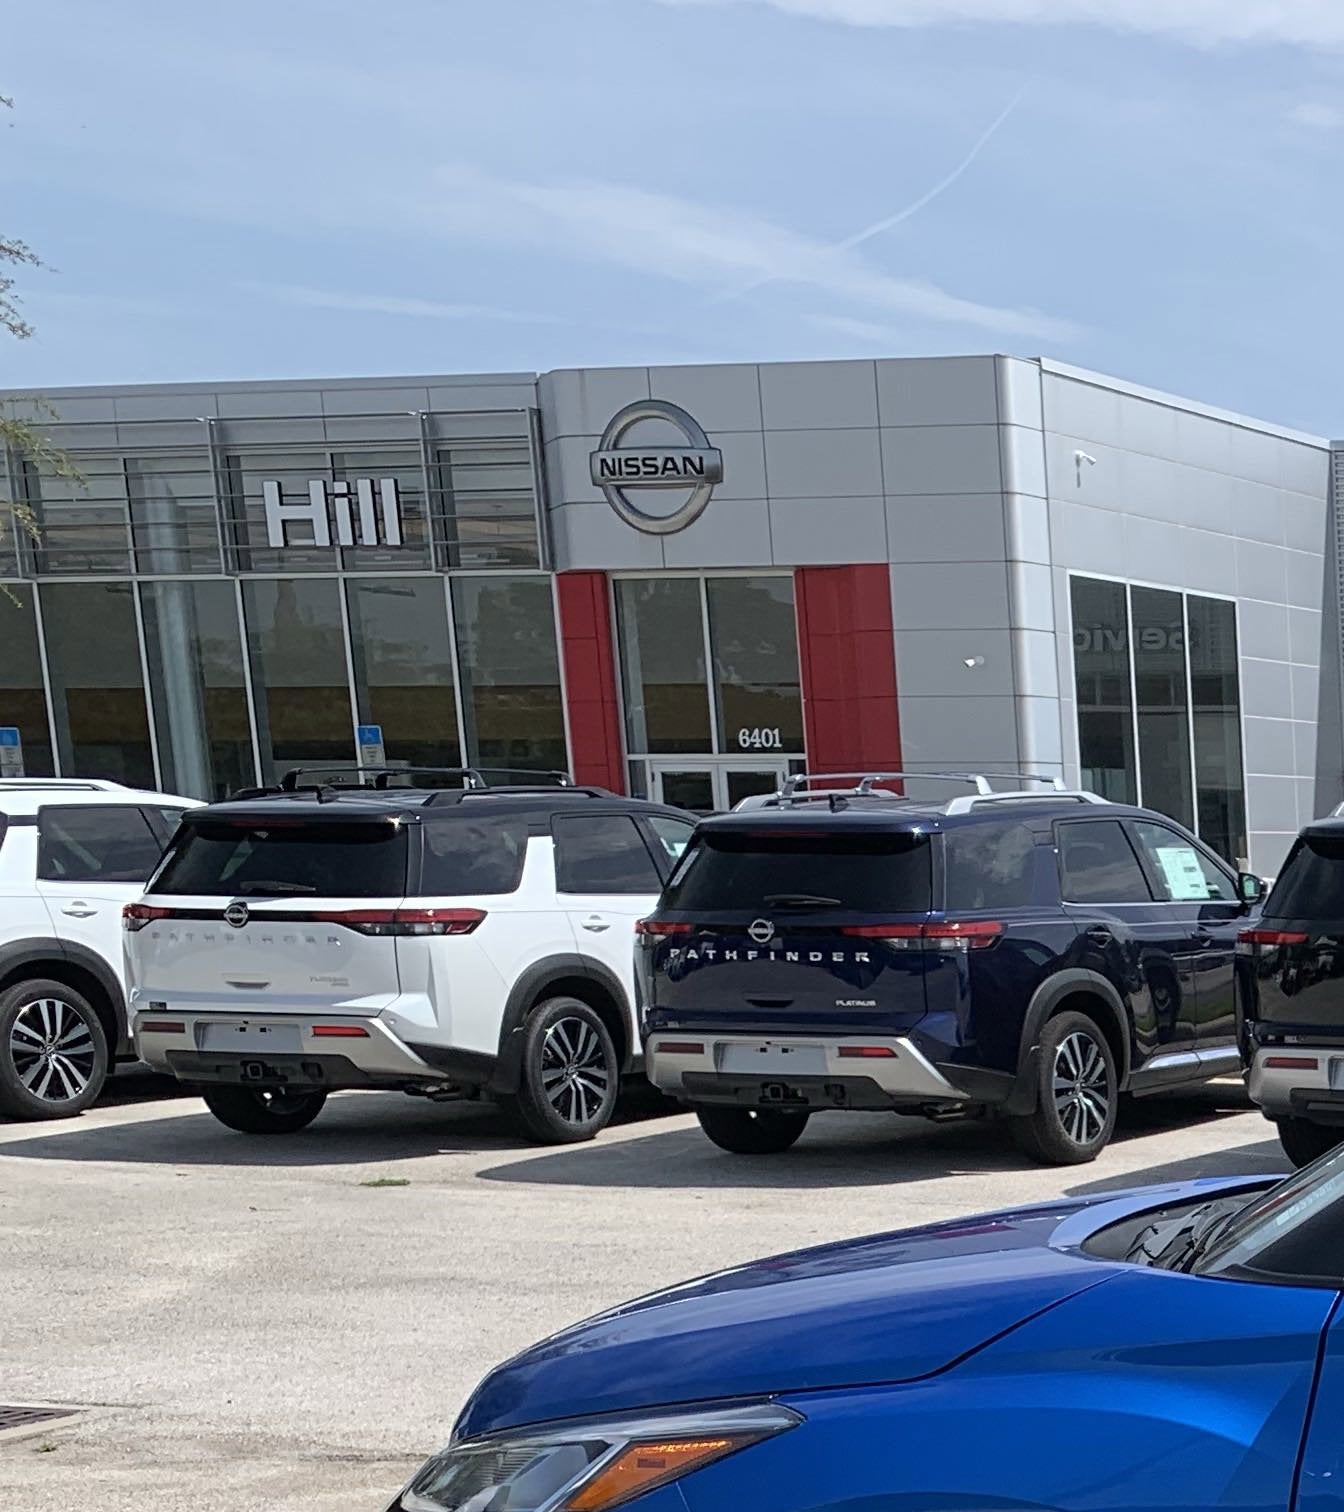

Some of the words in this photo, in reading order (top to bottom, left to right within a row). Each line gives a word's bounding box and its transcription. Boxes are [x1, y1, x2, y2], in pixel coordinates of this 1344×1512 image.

[600, 456, 705, 477] NISSAN
[263, 478, 402, 547] Hill
[738, 727, 783, 748] 6401
[669, 948, 871, 963] PATHFINDER
